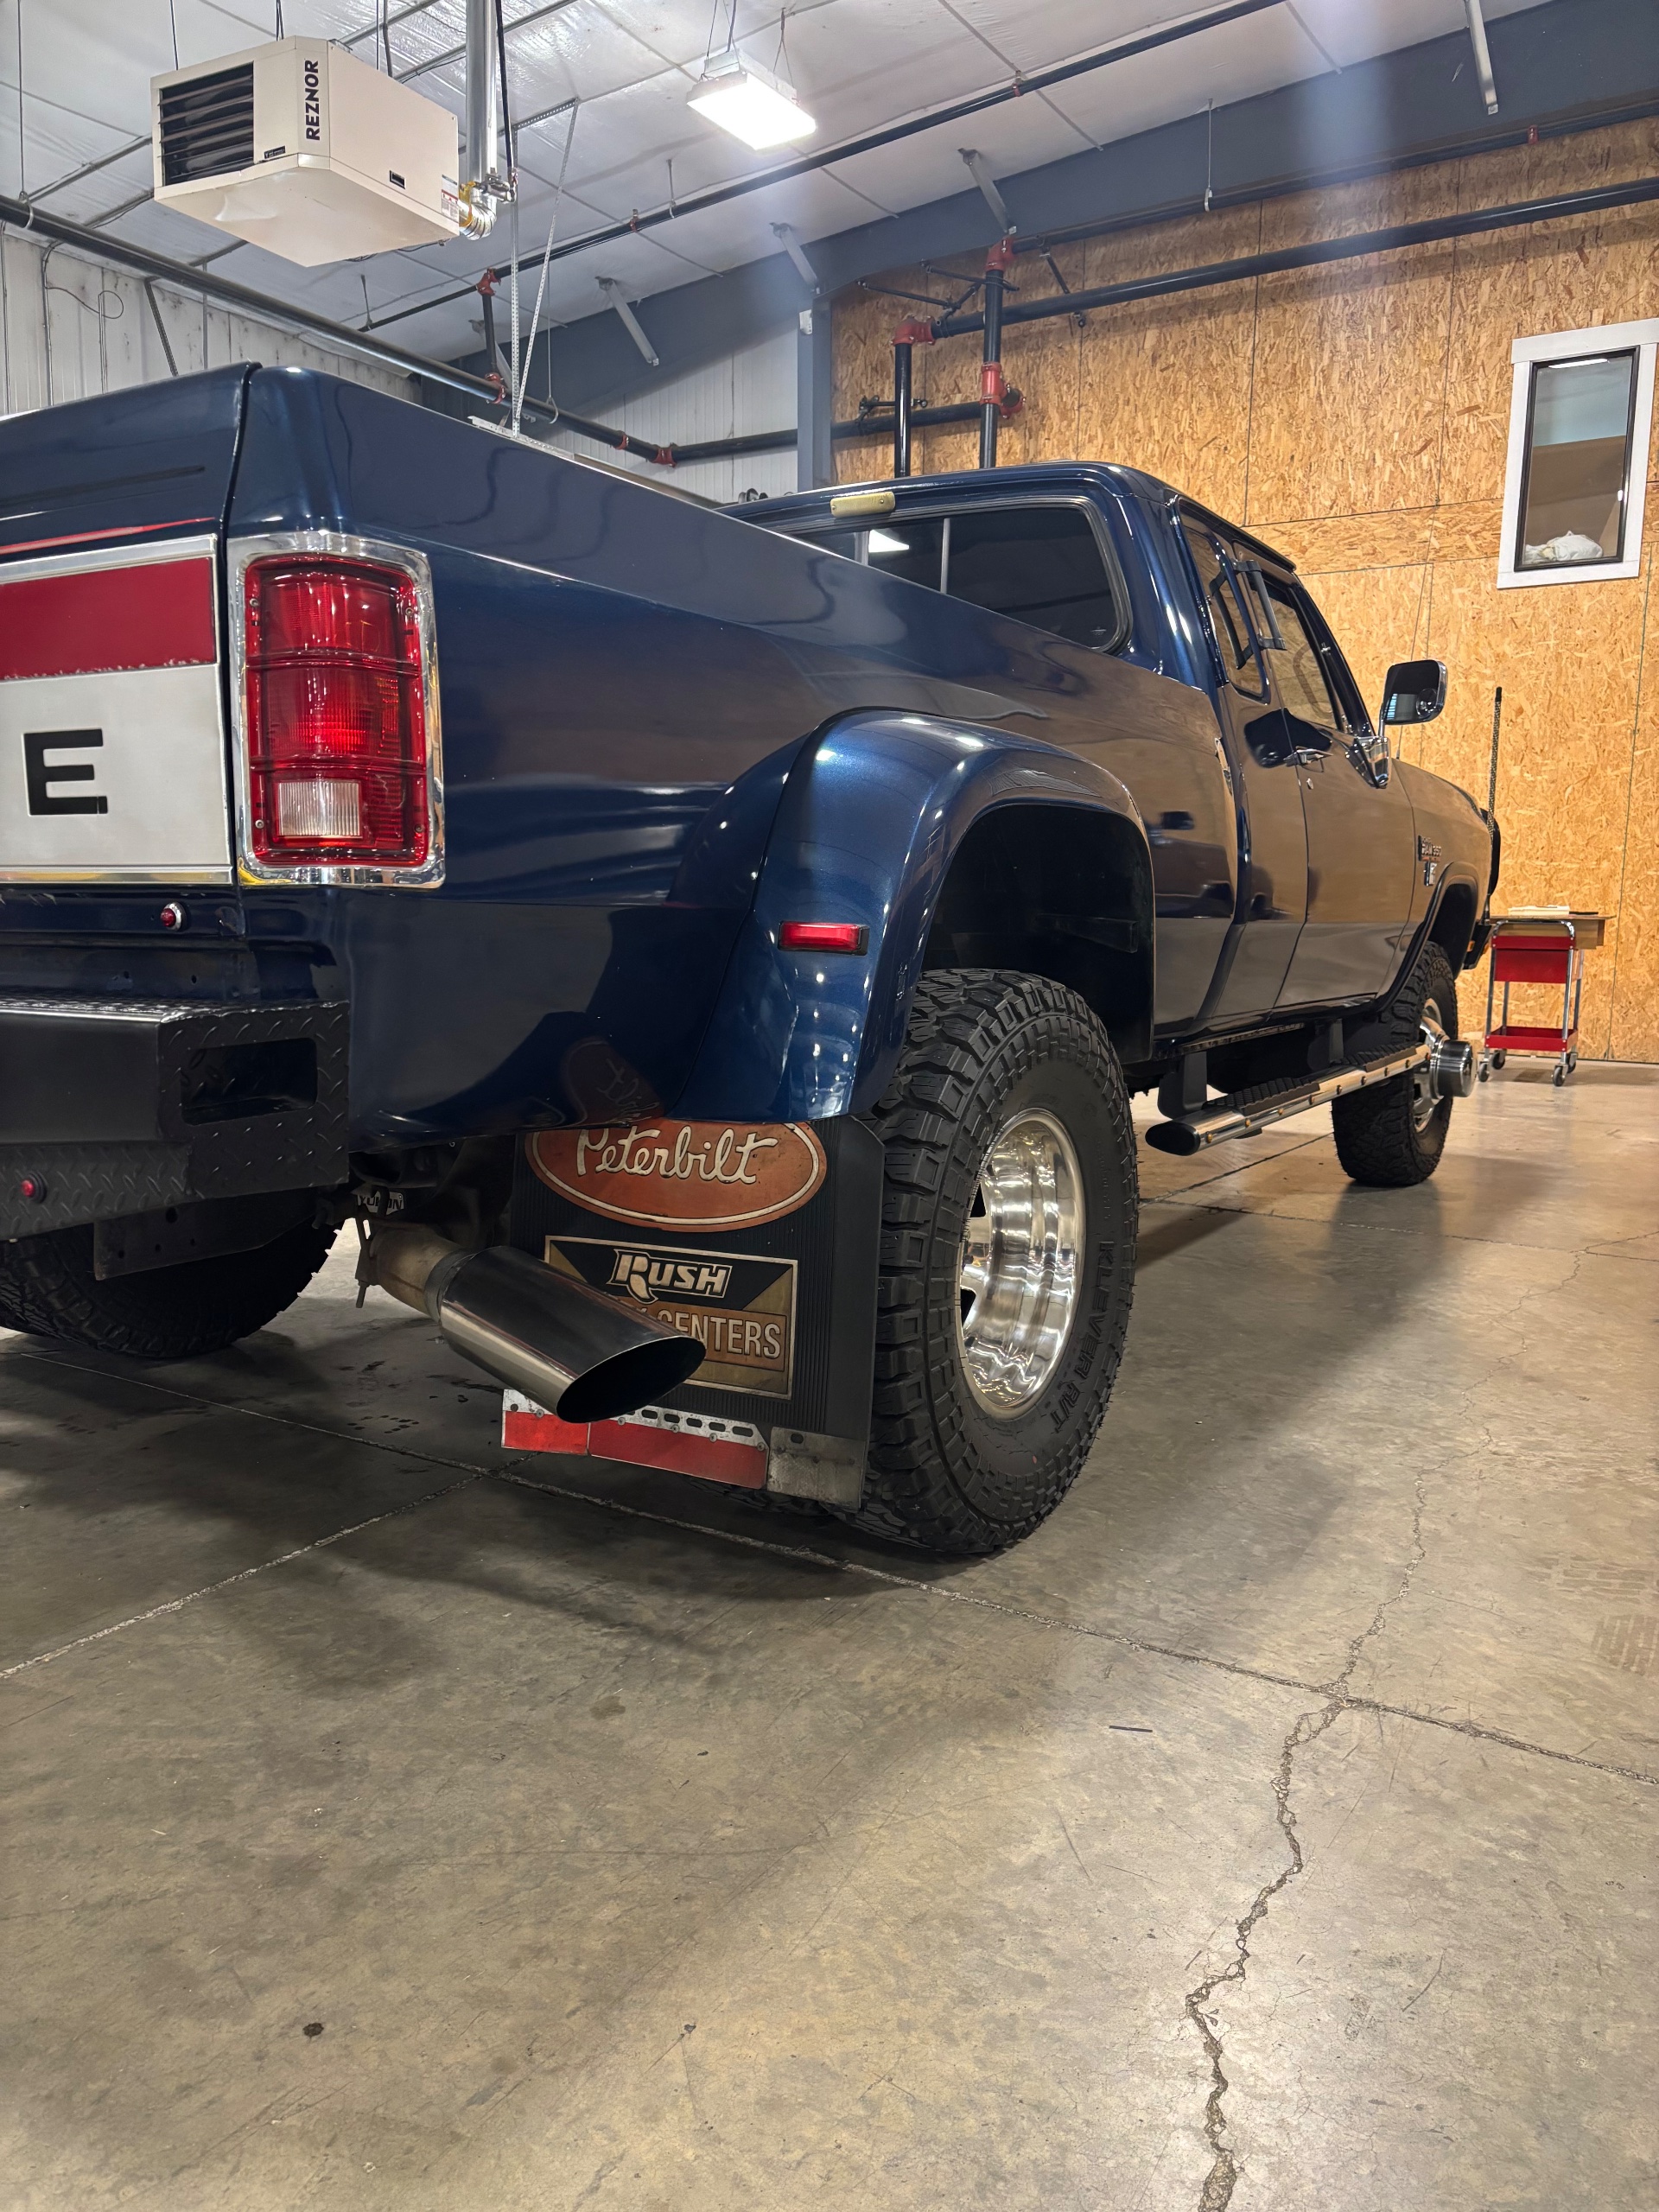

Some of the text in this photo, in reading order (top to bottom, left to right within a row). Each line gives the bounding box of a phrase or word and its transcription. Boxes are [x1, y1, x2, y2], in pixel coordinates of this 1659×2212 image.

[304, 60, 321, 141] REZNOR
[23, 728, 109, 817] E
[575, 1124, 779, 1185] Peterbilt
[610, 1250, 732, 1303] RUSH
[1074, 1241, 1116, 1381] KLEVER
[1050, 1381, 1082, 1434] R/T
